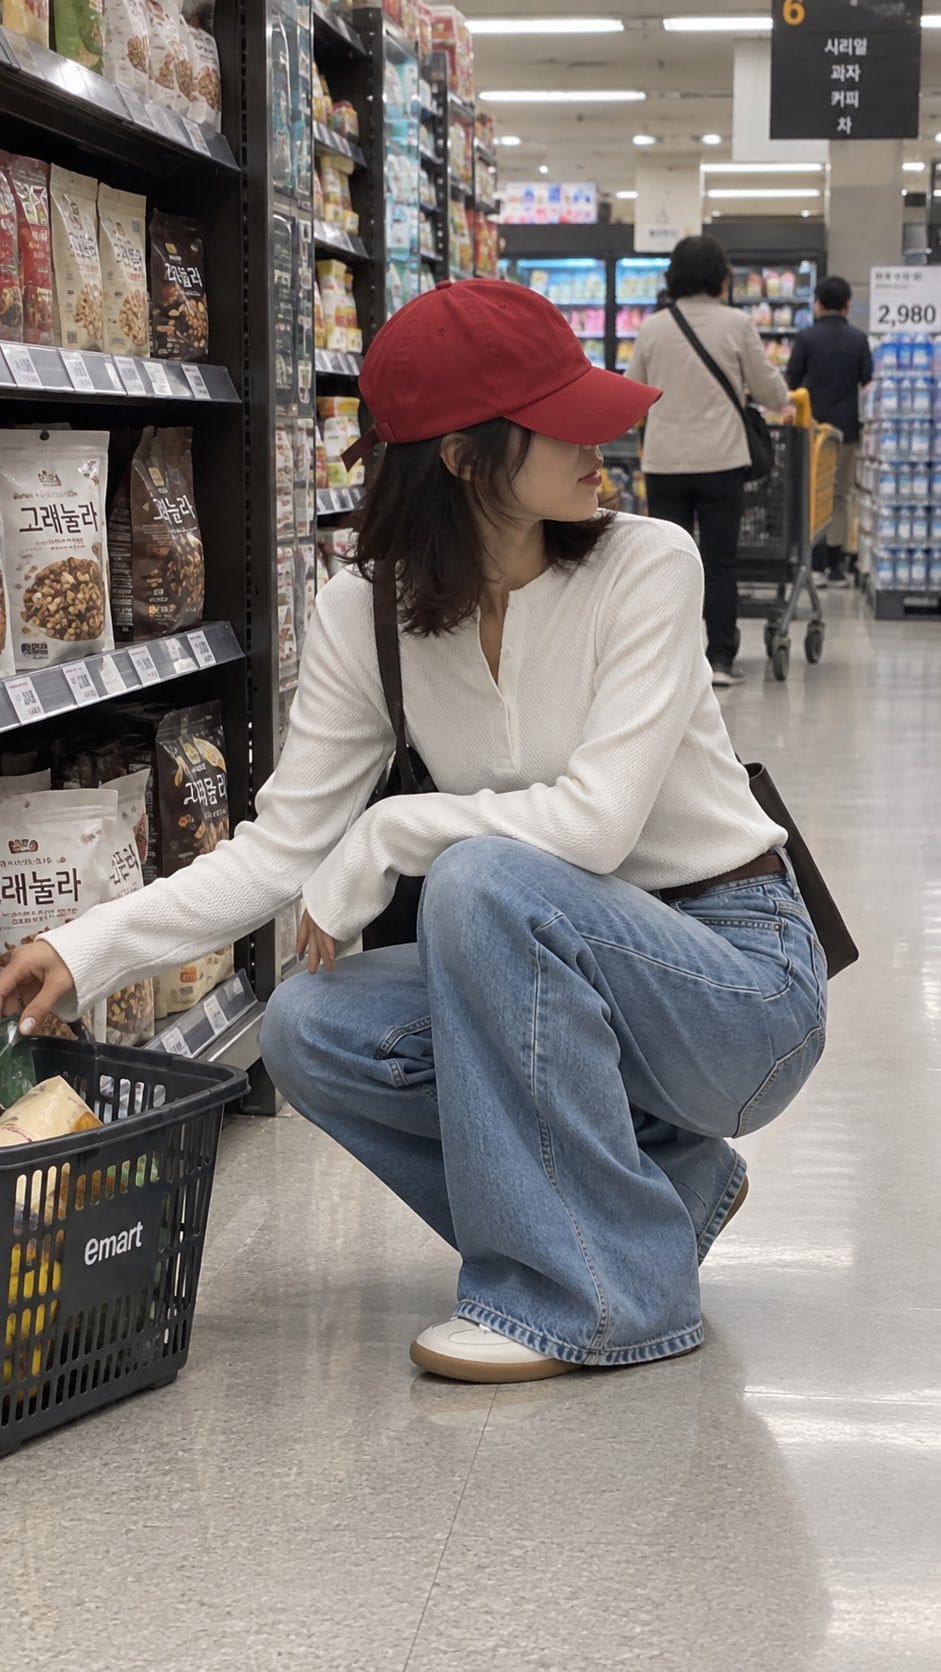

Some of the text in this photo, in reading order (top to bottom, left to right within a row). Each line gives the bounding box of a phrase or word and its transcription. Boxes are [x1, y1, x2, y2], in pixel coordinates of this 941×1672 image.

[783, 0, 805, 26] 6
[824, 38, 867, 56] 시리얼
[830, 63, 861, 82] 과자
[830, 90, 859, 108] 커피
[836, 116, 852, 135] 차
[878, 304, 936, 328] 2,980
[0, 868, 82, 906] 래눌라
[84, 1221, 143, 1266] emart
